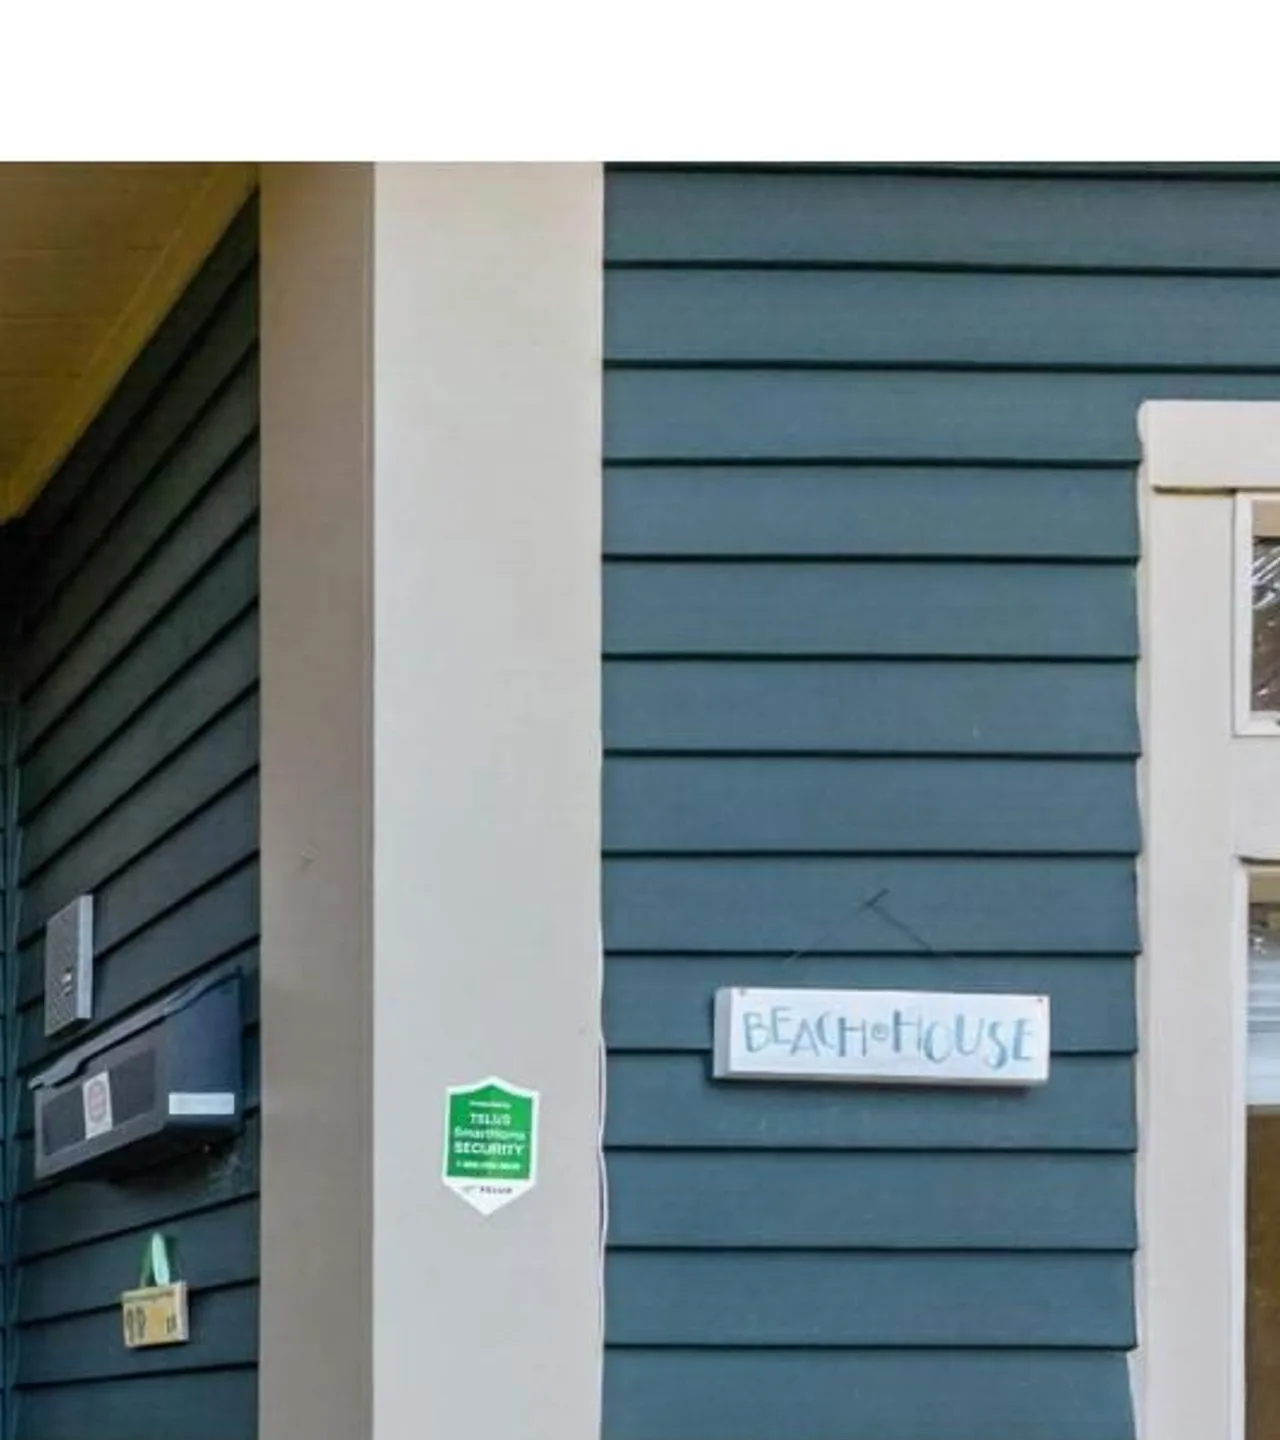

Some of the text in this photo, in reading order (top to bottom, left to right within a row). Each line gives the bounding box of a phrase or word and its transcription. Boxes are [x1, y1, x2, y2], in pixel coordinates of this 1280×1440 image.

[742, 1005, 1037, 1070] BEACH HOUSE
[454, 1141, 523, 1156] SECURITY
